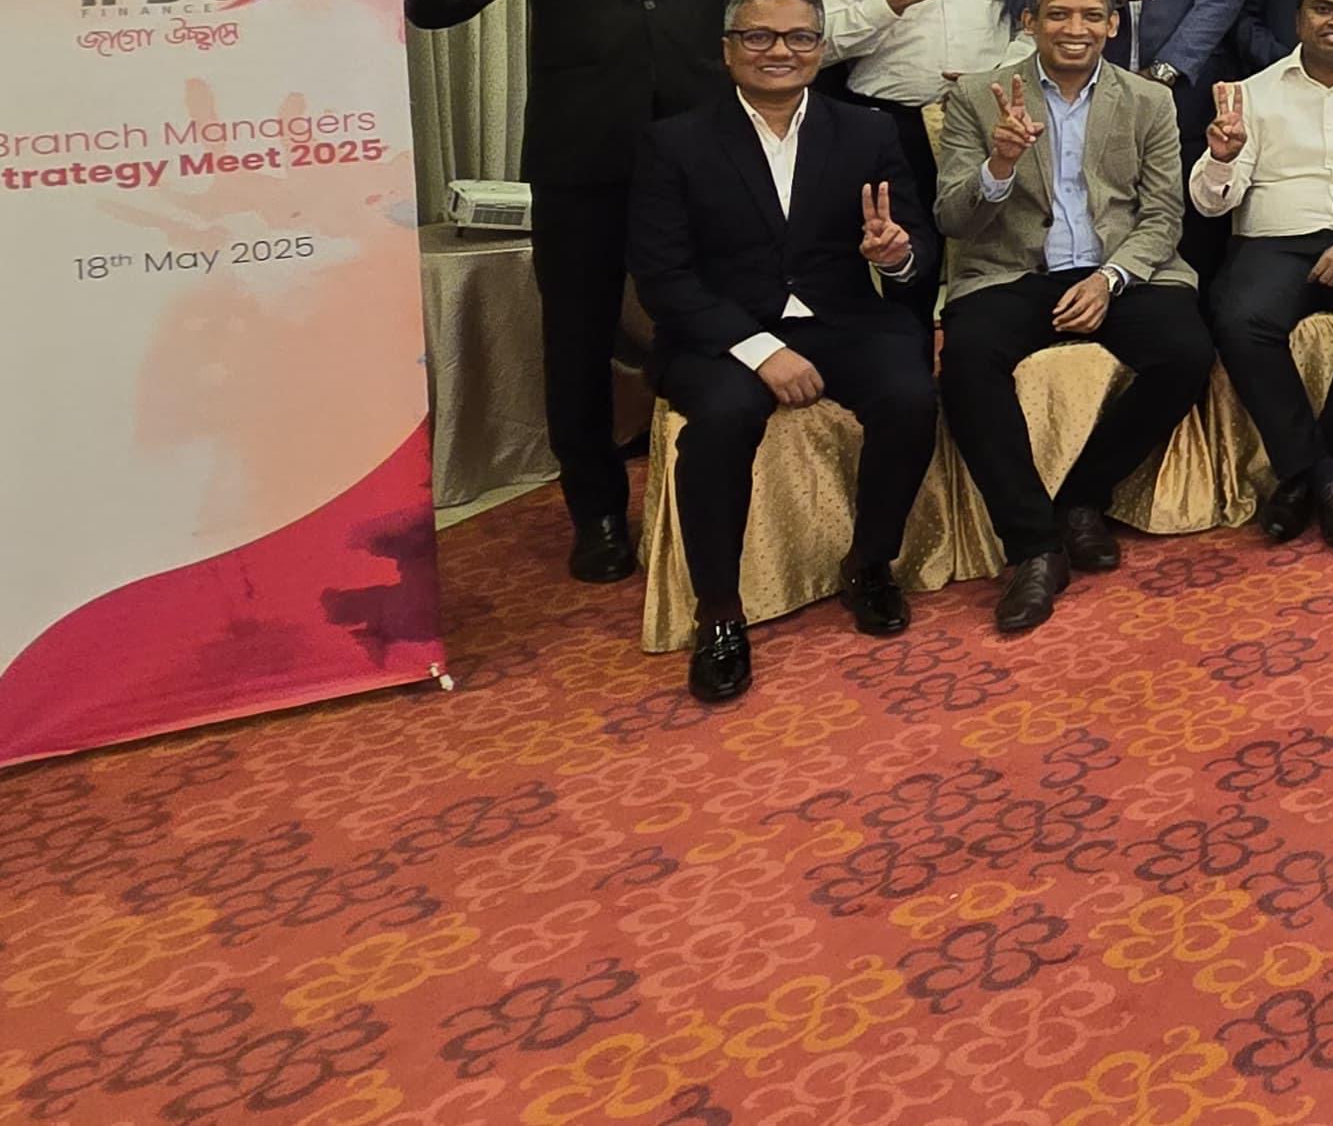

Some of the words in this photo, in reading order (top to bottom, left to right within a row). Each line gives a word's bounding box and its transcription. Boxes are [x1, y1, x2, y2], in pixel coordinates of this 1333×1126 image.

[81, 3, 213, 19] FINANCE
[77, 28, 156, 56] জাগো
[164, 109, 377, 144] Managers
[0, 159, 169, 190] trategy
[179, 146, 282, 176] Meet
[291, 139, 383, 167] 2025
[74, 252, 132, 281] 18th
[144, 248, 220, 274] May
[230, 236, 315, 264] 2025
